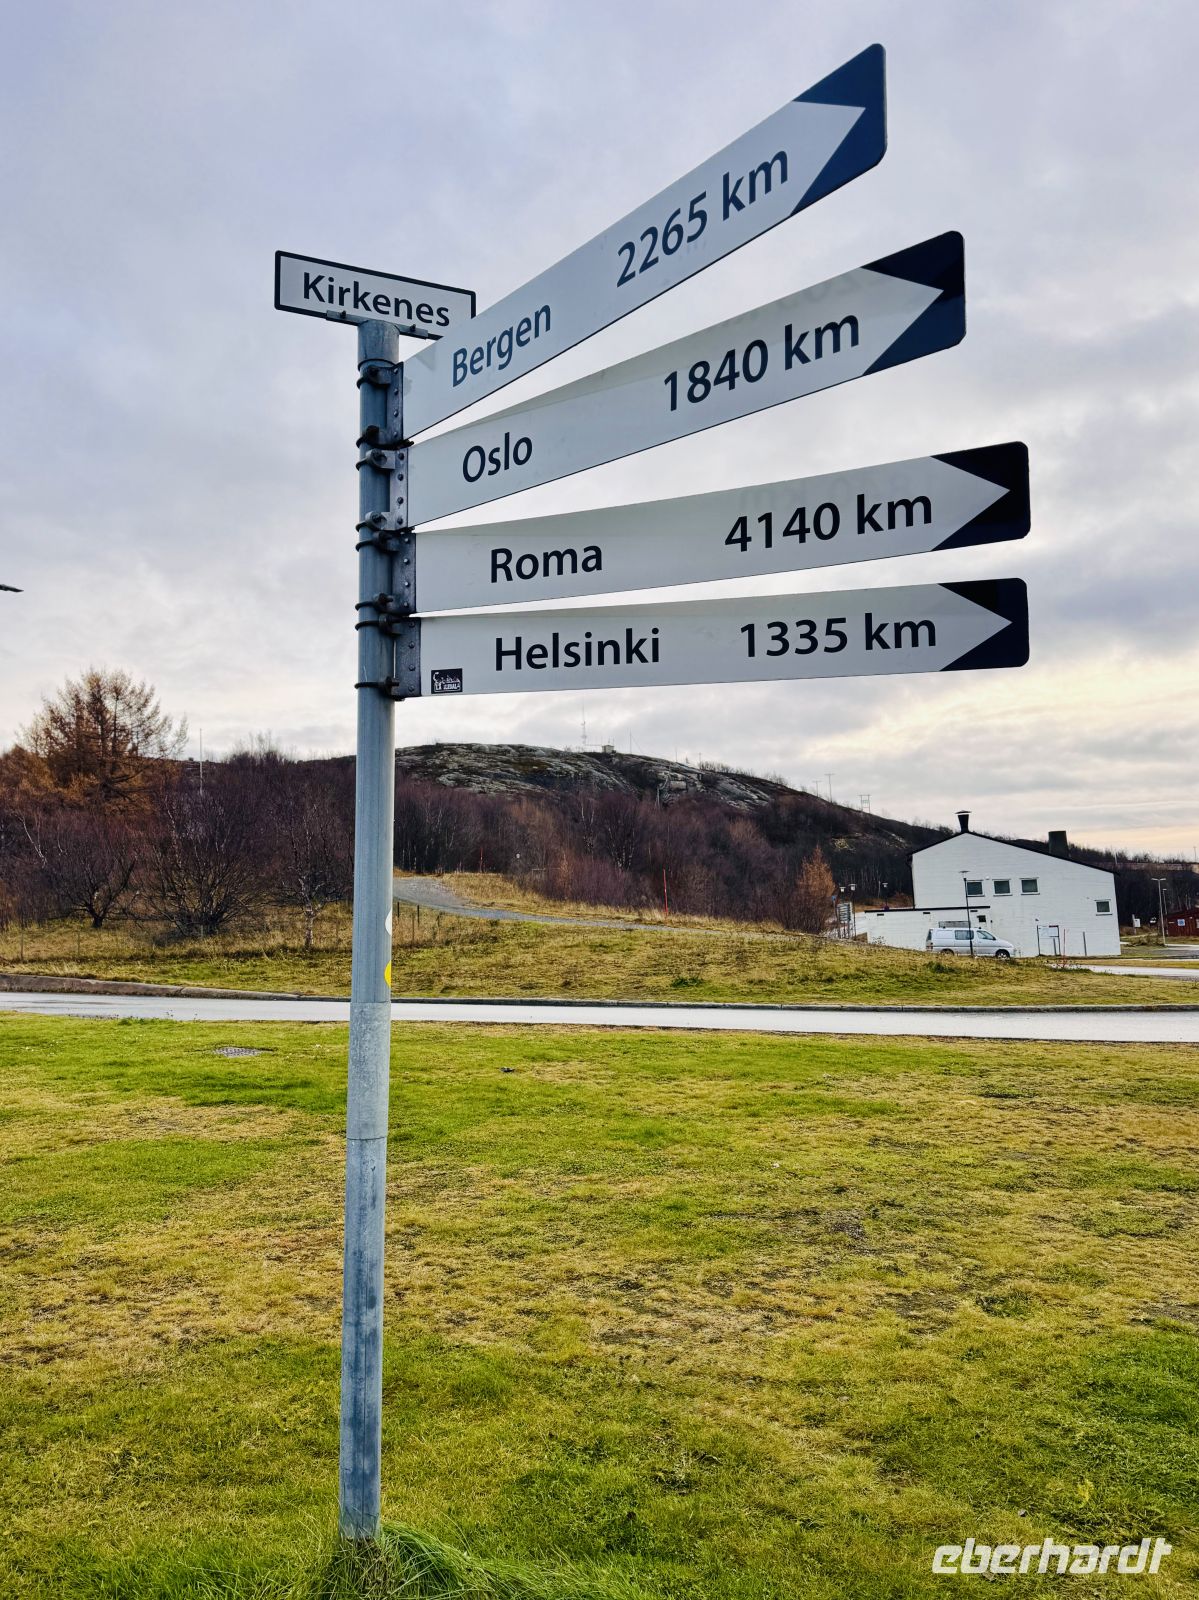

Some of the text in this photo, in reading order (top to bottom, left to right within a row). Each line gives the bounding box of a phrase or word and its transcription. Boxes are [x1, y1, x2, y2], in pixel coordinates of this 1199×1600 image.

[303, 271, 450, 327] Kirkenes
[452, 150, 788, 388] Bergen 2265 km
[462, 314, 860, 483] Oslo 1840 km
[490, 493, 932, 584] Roma 4140 km
[495, 612, 936, 671] Helsinki 1335 km
